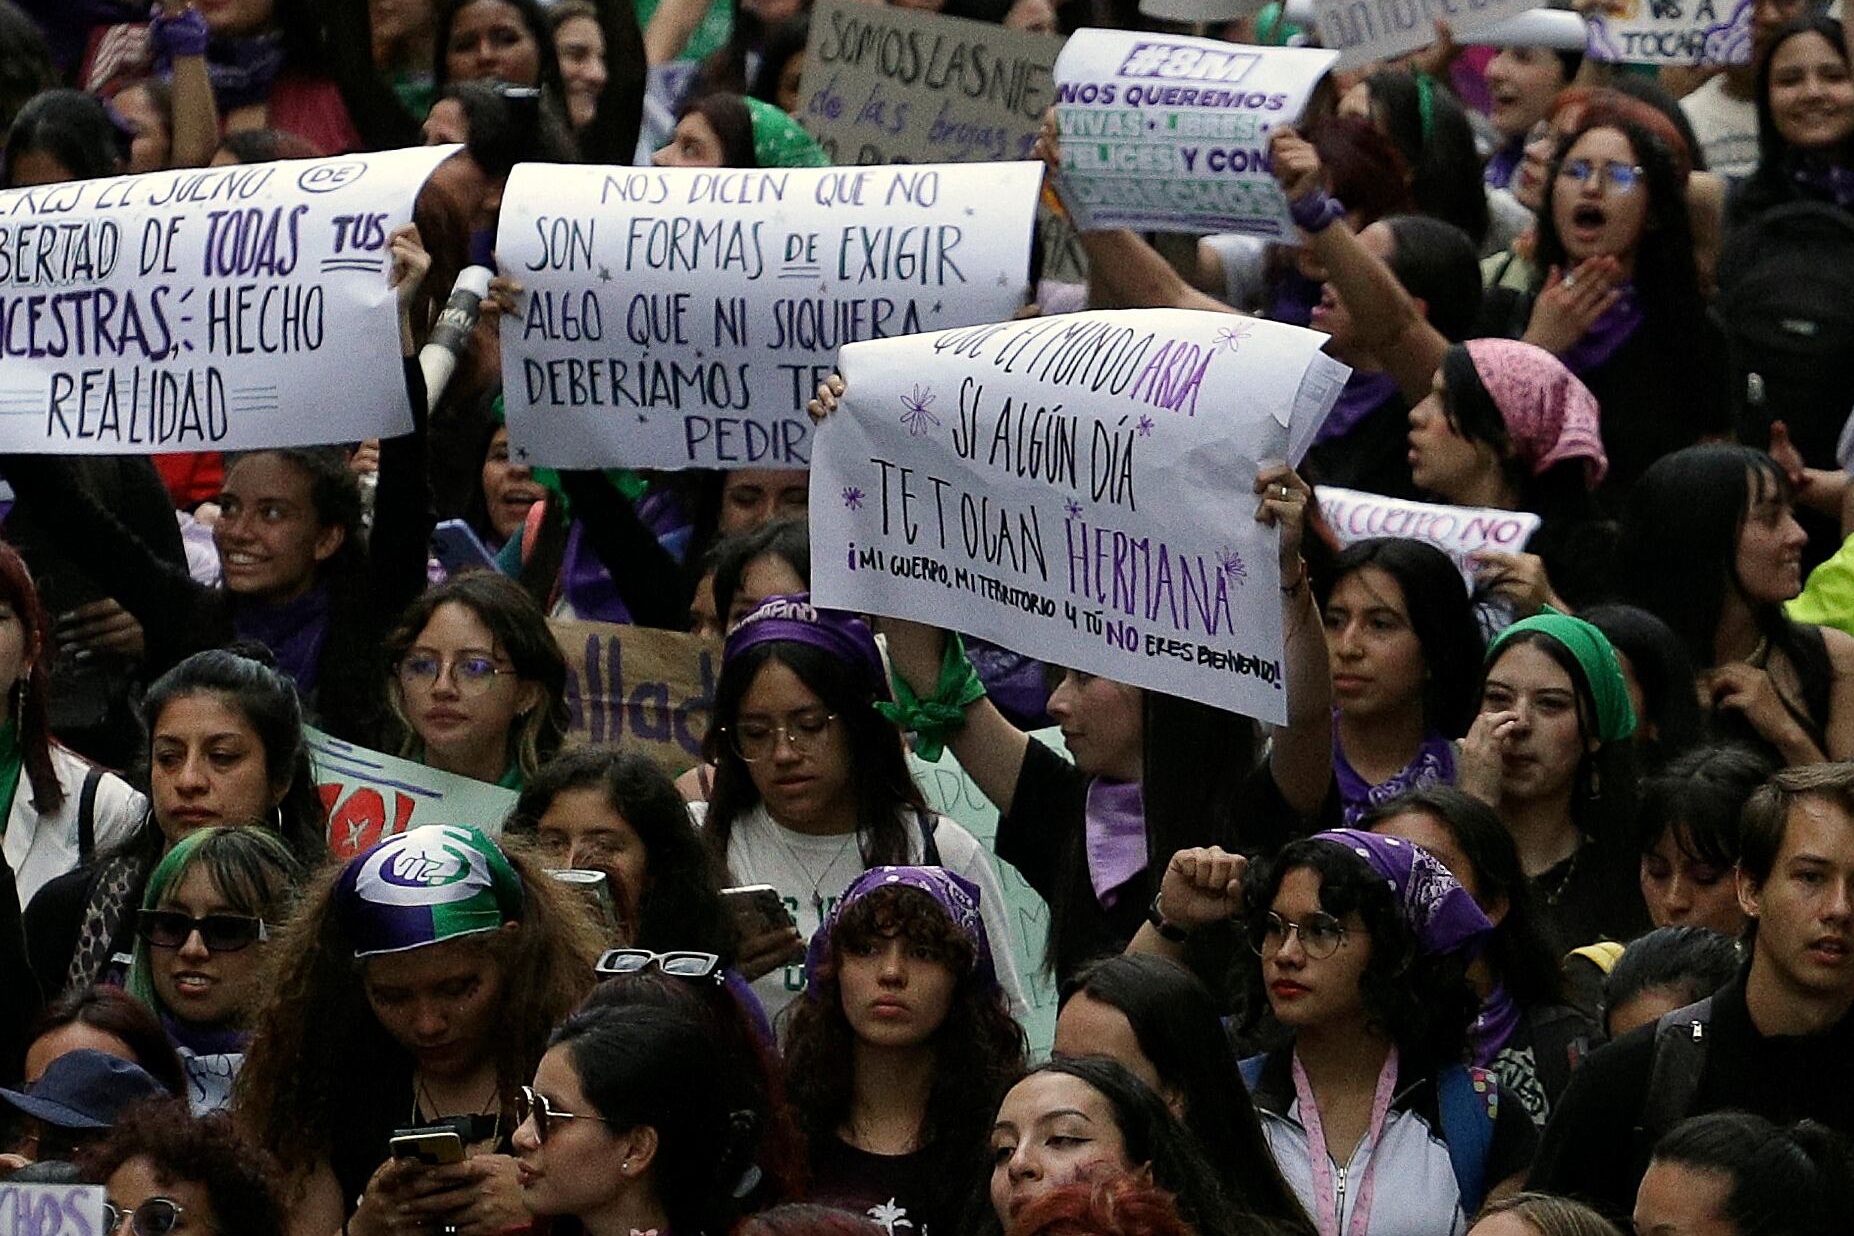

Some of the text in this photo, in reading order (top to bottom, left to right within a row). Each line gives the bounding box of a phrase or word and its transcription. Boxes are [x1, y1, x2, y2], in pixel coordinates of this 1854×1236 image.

[1055, 82, 1289, 111] NOS QUEREMOS
[1118, 42, 1262, 82] #8M
[600, 171, 940, 209] NOS DICEN QUE NO
[1180, 148, 1199, 172] Y
[138, 215, 186, 277] DE
[202, 205, 310, 278] TODAS
[332, 212, 389, 254] TUS
[524, 216, 966, 286] SON FORMAS DE EXIGIR
[208, 284, 324, 355] HECHO
[523, 289, 923, 351] ALGO QUE NI SIQUIERA
[1030, 319, 1155, 396] MUNDO
[1128, 337, 1216, 417] ARDA
[46, 365, 228, 445] REALIDAD
[952, 375, 1137, 512] SI ALGÚN DÍA
[870, 457, 1049, 582] TE TOCAN
[1458, 517, 1521, 545] NO
[1064, 516, 1235, 636] HERMANA
[1105, 619, 1140, 653] NO
[1144, 633, 1195, 662] ERES
